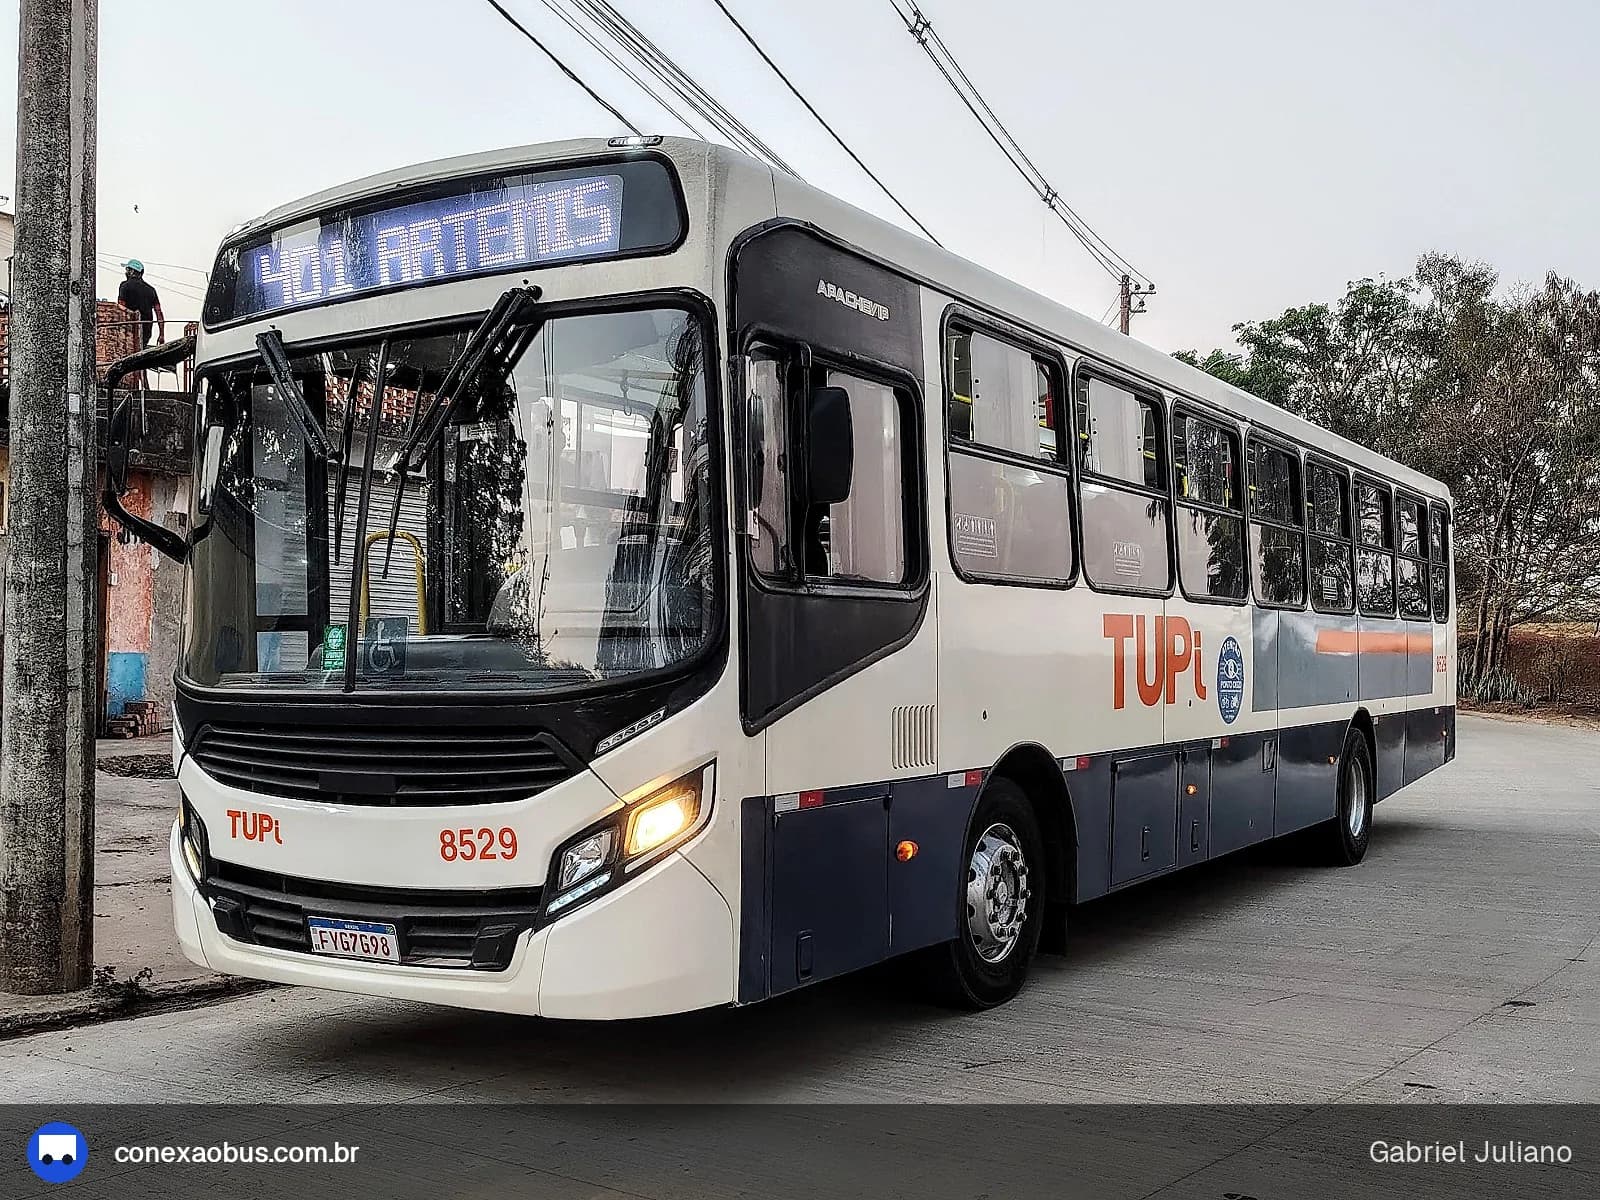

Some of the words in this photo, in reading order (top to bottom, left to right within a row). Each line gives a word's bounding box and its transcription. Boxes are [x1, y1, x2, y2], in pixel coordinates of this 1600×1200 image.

[260, 239, 353, 304] 401
[377, 180, 614, 287] ARTEMIS
[439, 827, 519, 862] 8529
[319, 930, 390, 957] FYG7G98
